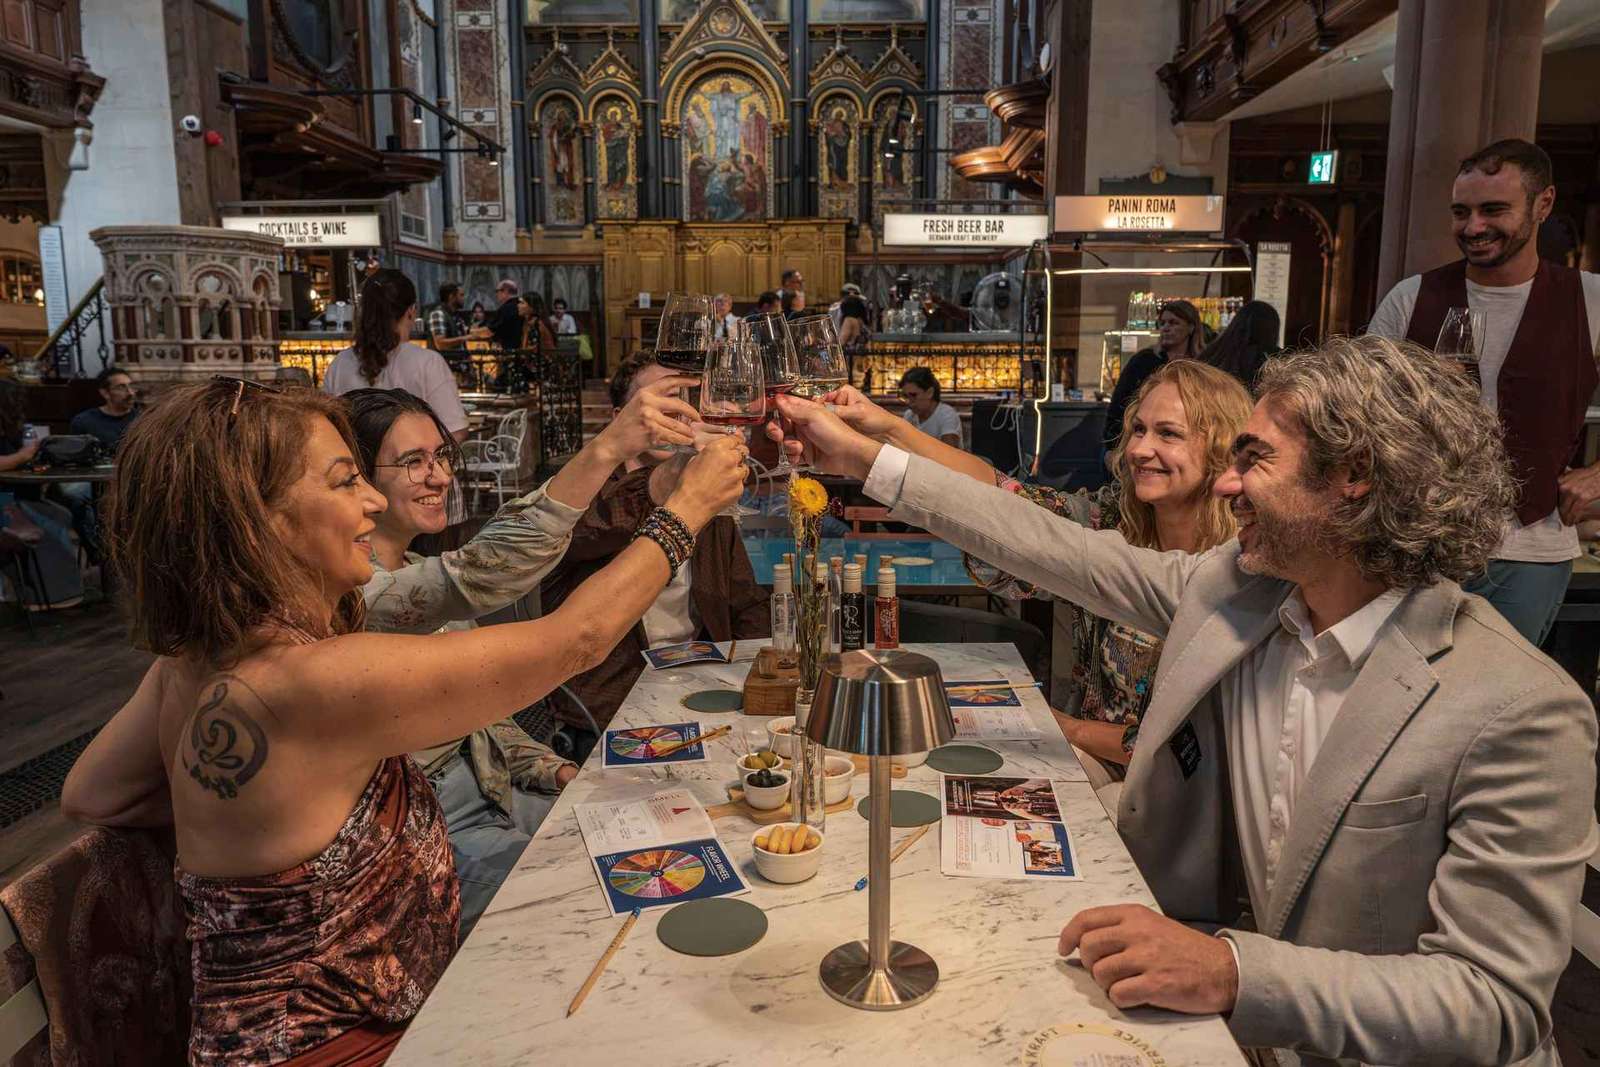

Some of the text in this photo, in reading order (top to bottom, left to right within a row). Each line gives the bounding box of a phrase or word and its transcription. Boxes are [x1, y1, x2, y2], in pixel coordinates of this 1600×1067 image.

[1108, 198, 1176, 213] PANINI ROMA
[258, 221, 347, 236] COCKTAILS & WINE
[923, 219, 1005, 233] FRESH BEER BAR
[1118, 215, 1165, 229] LA ROSETTA
[1113, 1030, 1166, 1067] ERVICE
